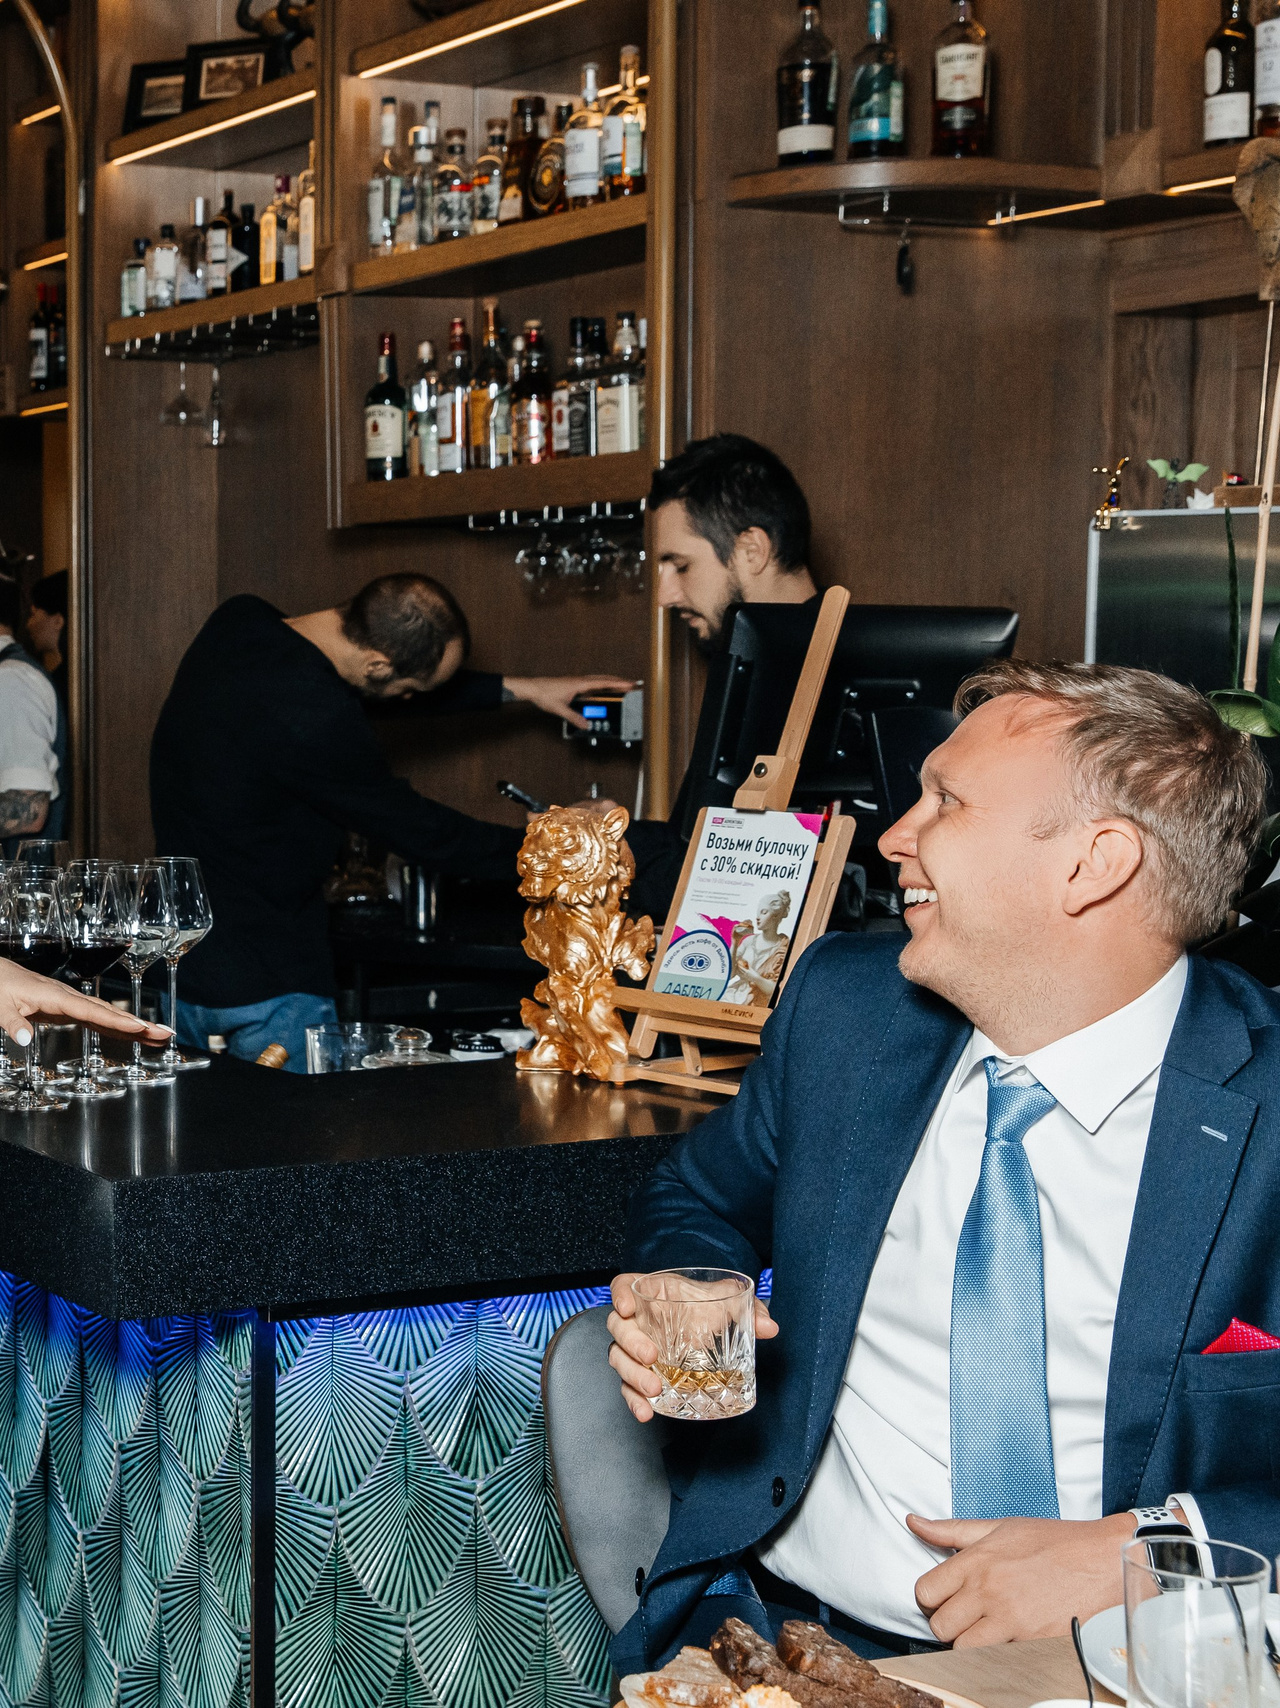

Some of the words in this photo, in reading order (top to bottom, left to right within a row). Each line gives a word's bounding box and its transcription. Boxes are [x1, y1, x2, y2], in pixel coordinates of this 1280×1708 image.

[706, 832, 753, 852] Возьми
[755, 836, 810, 861] булочку
[700, 858, 708, 871] с
[710, 855, 737, 874] 30%
[740, 862, 802, 880] скидкой!
